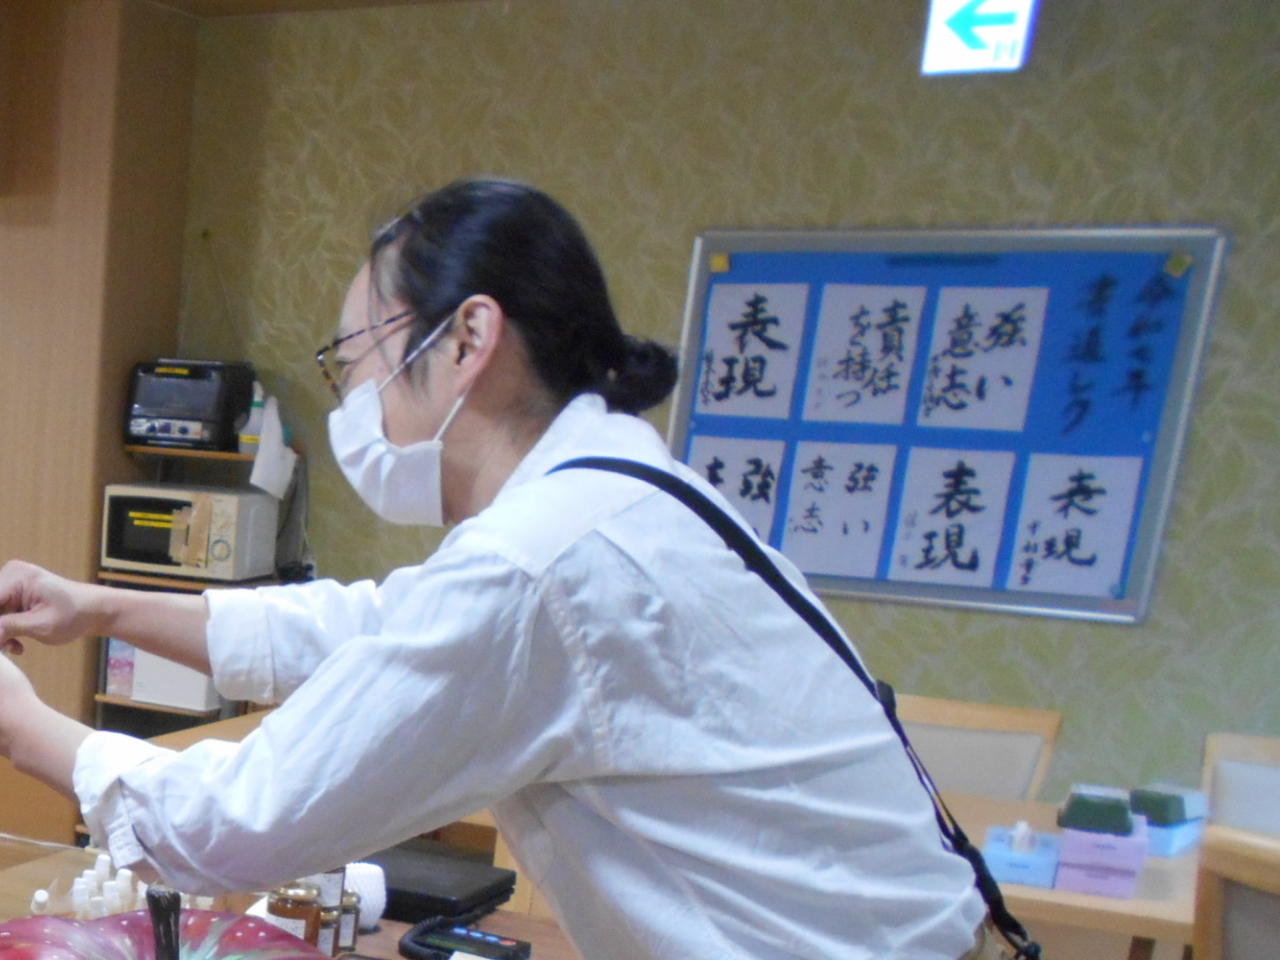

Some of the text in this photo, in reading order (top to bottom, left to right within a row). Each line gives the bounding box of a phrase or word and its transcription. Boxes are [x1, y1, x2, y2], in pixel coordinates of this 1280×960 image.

[712, 292, 790, 402] 表現
[914, 459, 987, 572] 表現
[1042, 468, 1106, 568] 表現
